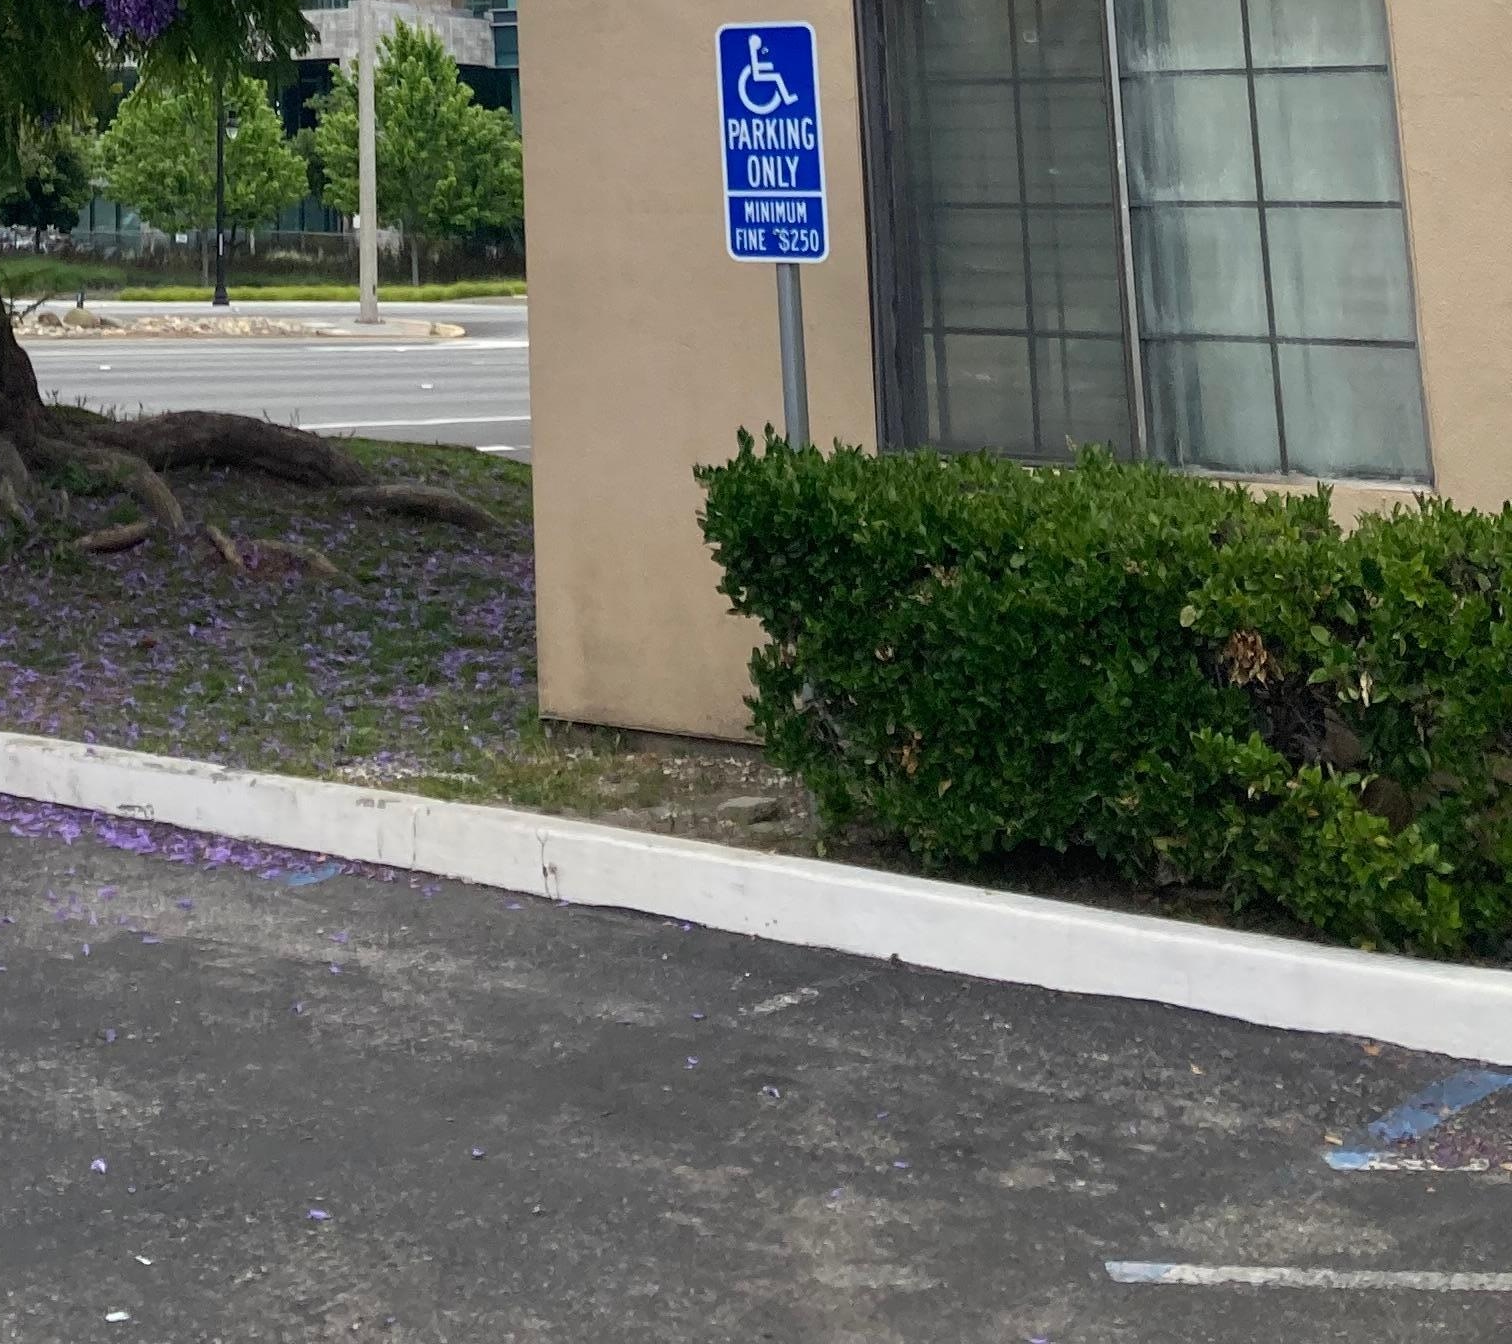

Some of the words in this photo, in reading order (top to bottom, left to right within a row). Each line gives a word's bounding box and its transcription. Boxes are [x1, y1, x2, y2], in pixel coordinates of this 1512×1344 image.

[727, 116, 815, 150] PARKING
[747, 155, 799, 188] ONLY
[744, 200, 807, 224] MINIMUM
[735, 228, 767, 251] FINE
[778, 228, 820, 253] $250
